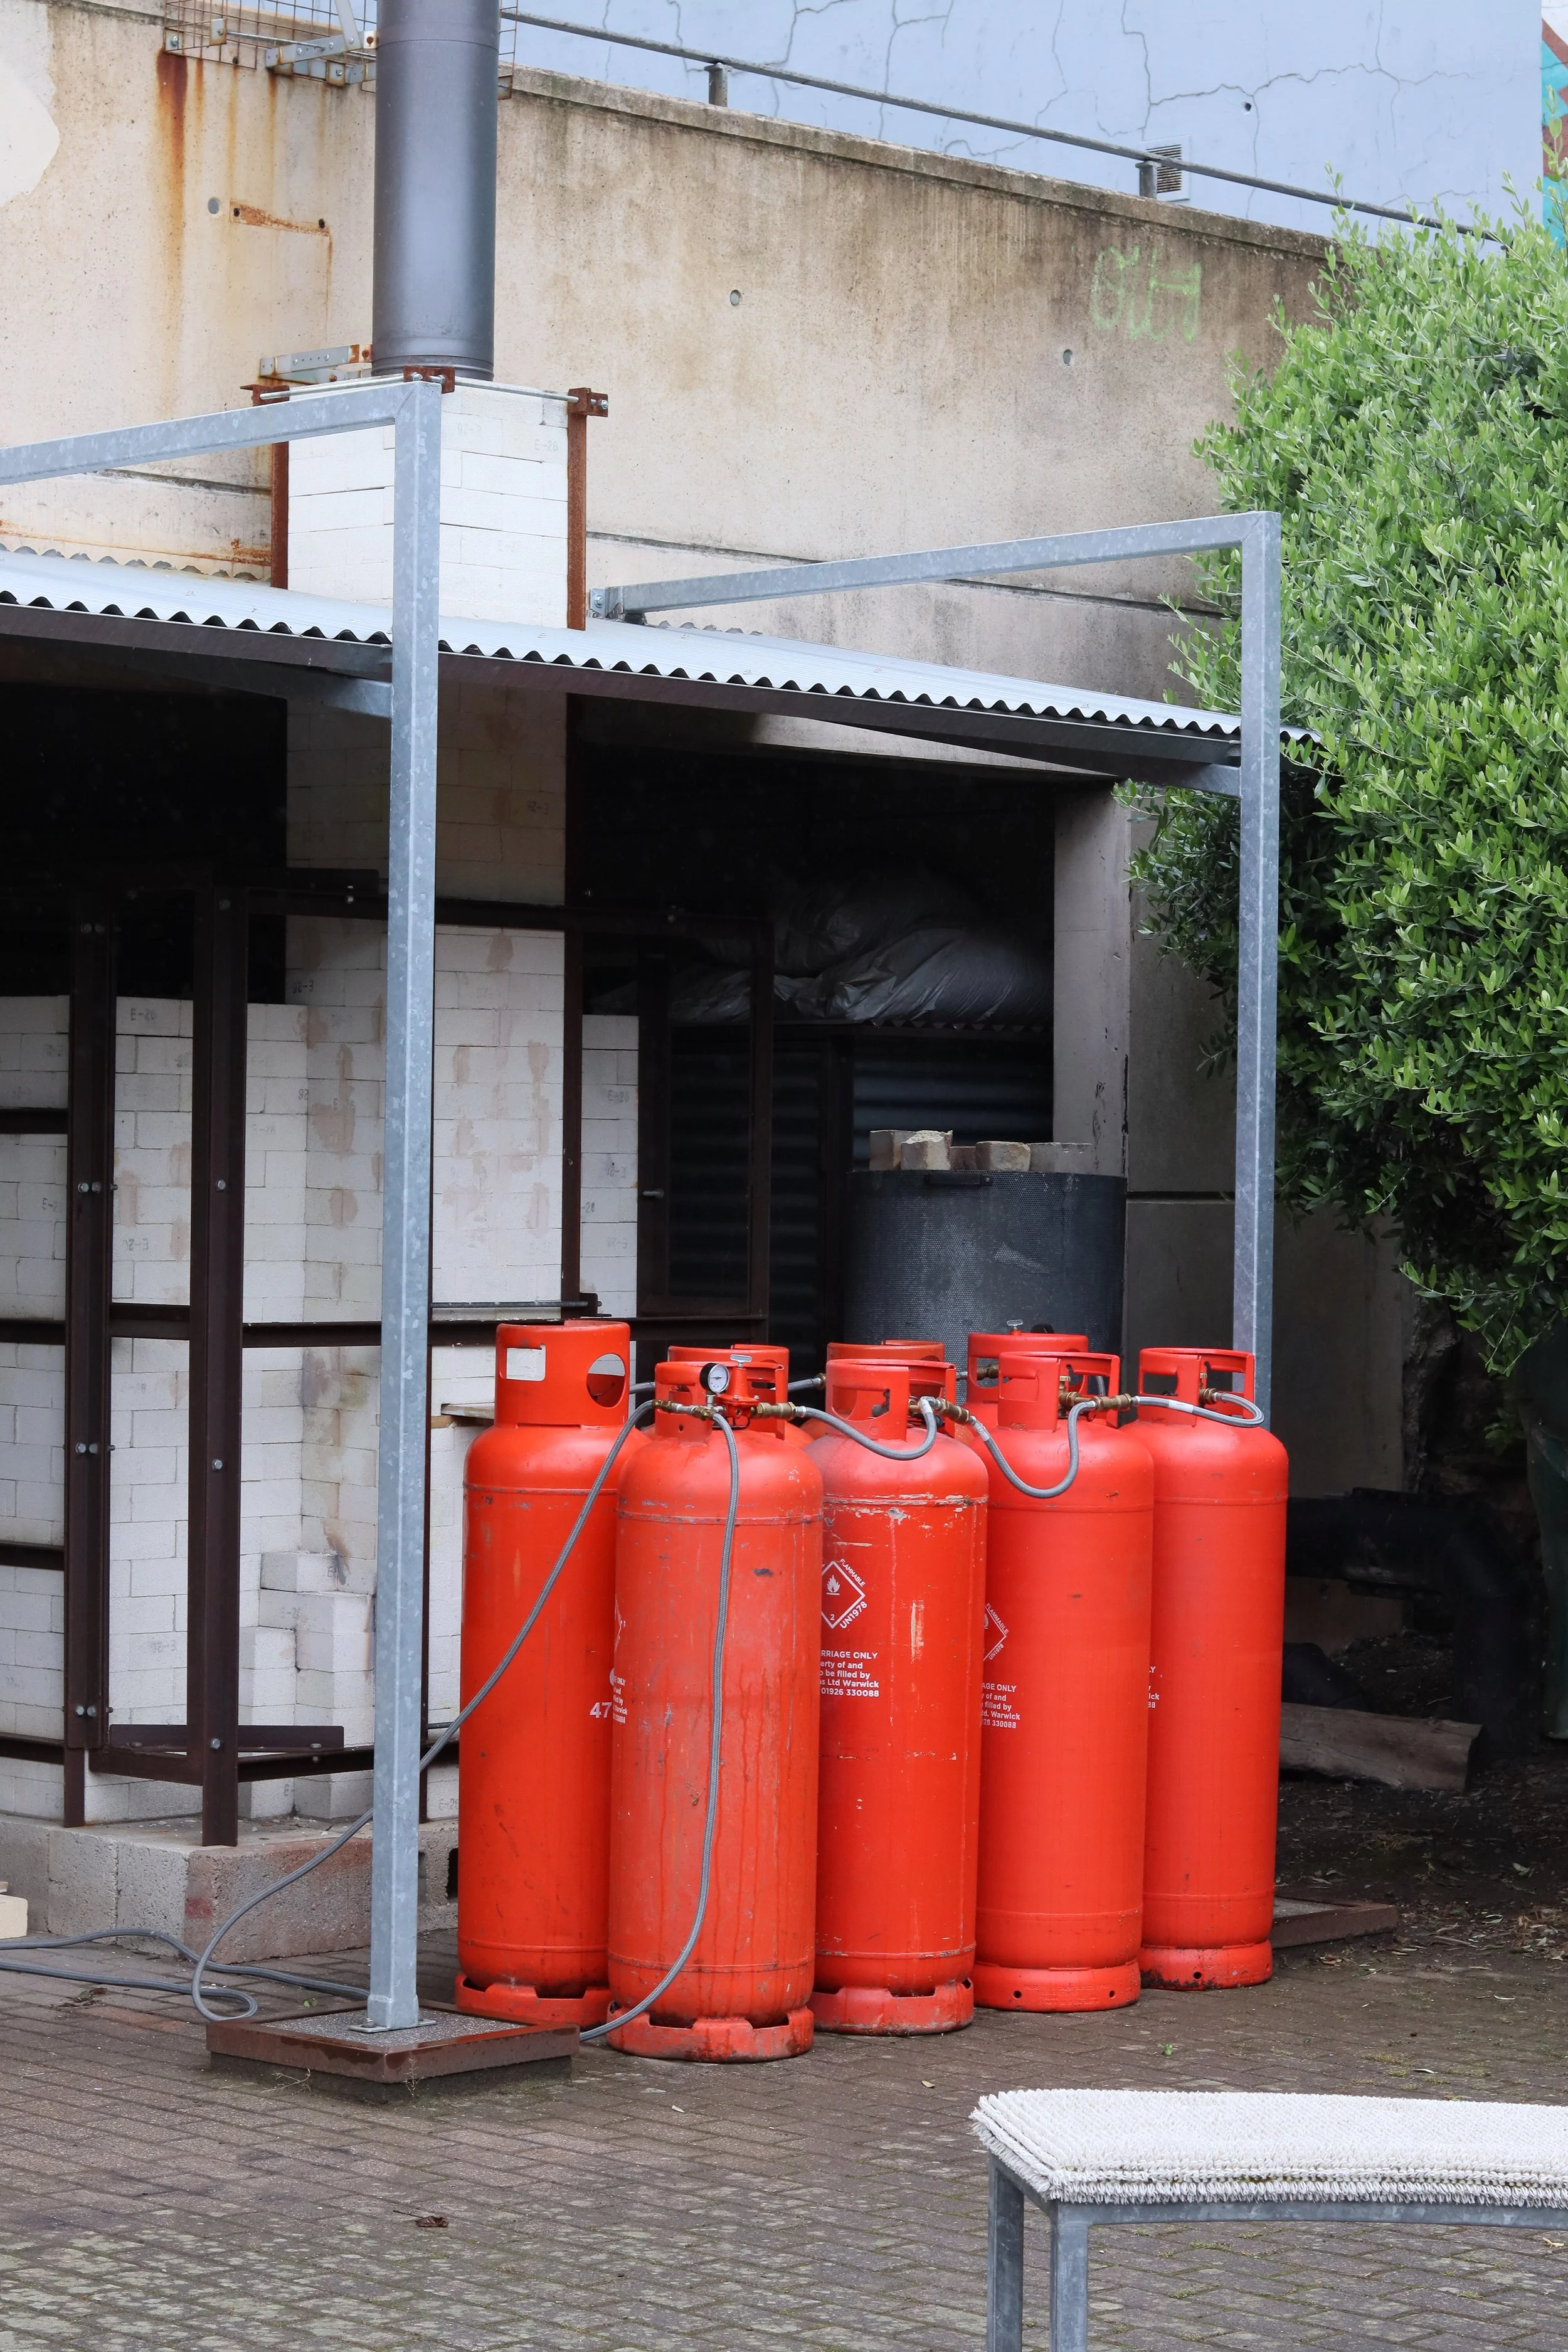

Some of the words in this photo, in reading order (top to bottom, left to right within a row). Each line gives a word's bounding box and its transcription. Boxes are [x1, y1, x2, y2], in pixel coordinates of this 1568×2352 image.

[839, 1601, 867, 1629] UN1978
[986, 1602, 1009, 1635] FLAMMABLE
[853, 1651, 878, 1660] ONLY
[988, 1643, 1004, 1660] UN1978
[837, 1670, 857, 1678] filled
[860, 1671, 871, 1680] by
[843, 1680, 879, 1688] Warwick
[997, 1684, 1017, 1692] ONLY
[590, 1702, 612, 1719] 47
[985, 1702, 1001, 1710] filled
[1003, 1703, 1012, 1712] by
[991, 1711, 1020, 1720] Warwick
[992, 1720, 1017, 1729] 330088
